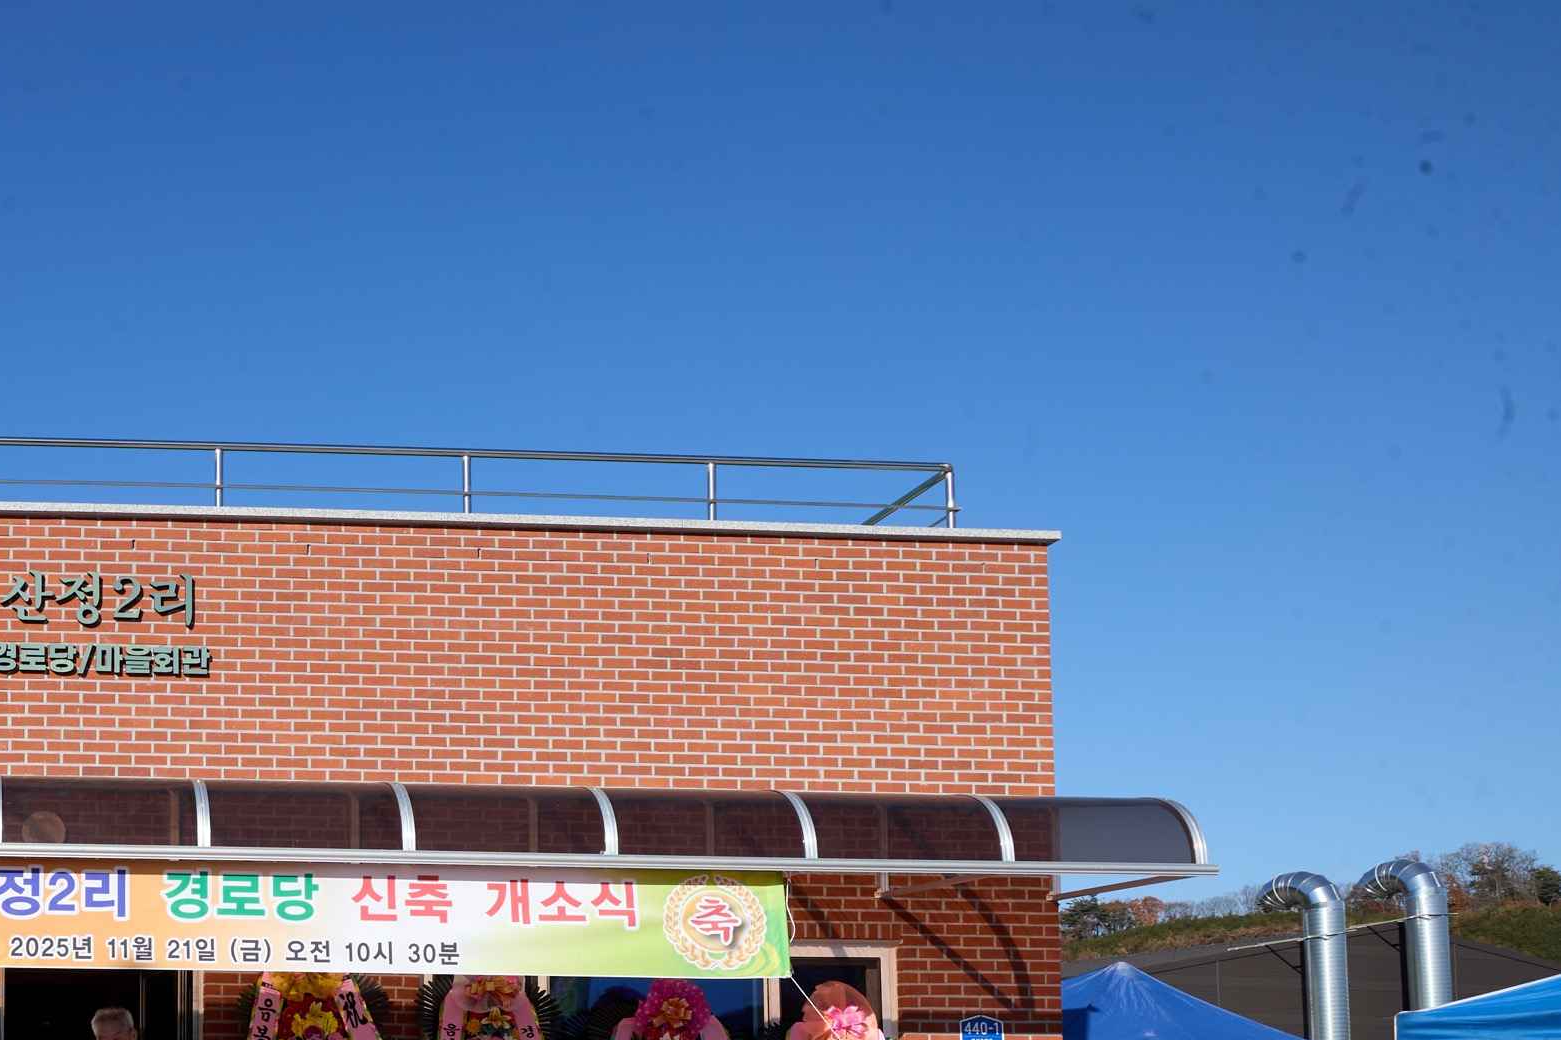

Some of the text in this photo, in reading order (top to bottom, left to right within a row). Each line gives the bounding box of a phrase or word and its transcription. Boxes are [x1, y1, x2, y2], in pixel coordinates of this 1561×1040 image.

[1, 570, 195, 630] 산정2리
[165, 870, 319, 921] 경로당
[351, 874, 454, 924] 신축
[485, 878, 637, 928] 개소식
[690, 897, 741, 943] 축
[10, 936, 93, 960] 2025년
[108, 936, 153, 961] 11월
[167, 939, 216, 962] 21일
[229, 938, 272, 963] (금)
[285, 940, 332, 964] 오전
[345, 940, 394, 965] 10시
[407, 941, 461, 966] 30분
[964, 1021, 1000, 1036] 440-1
